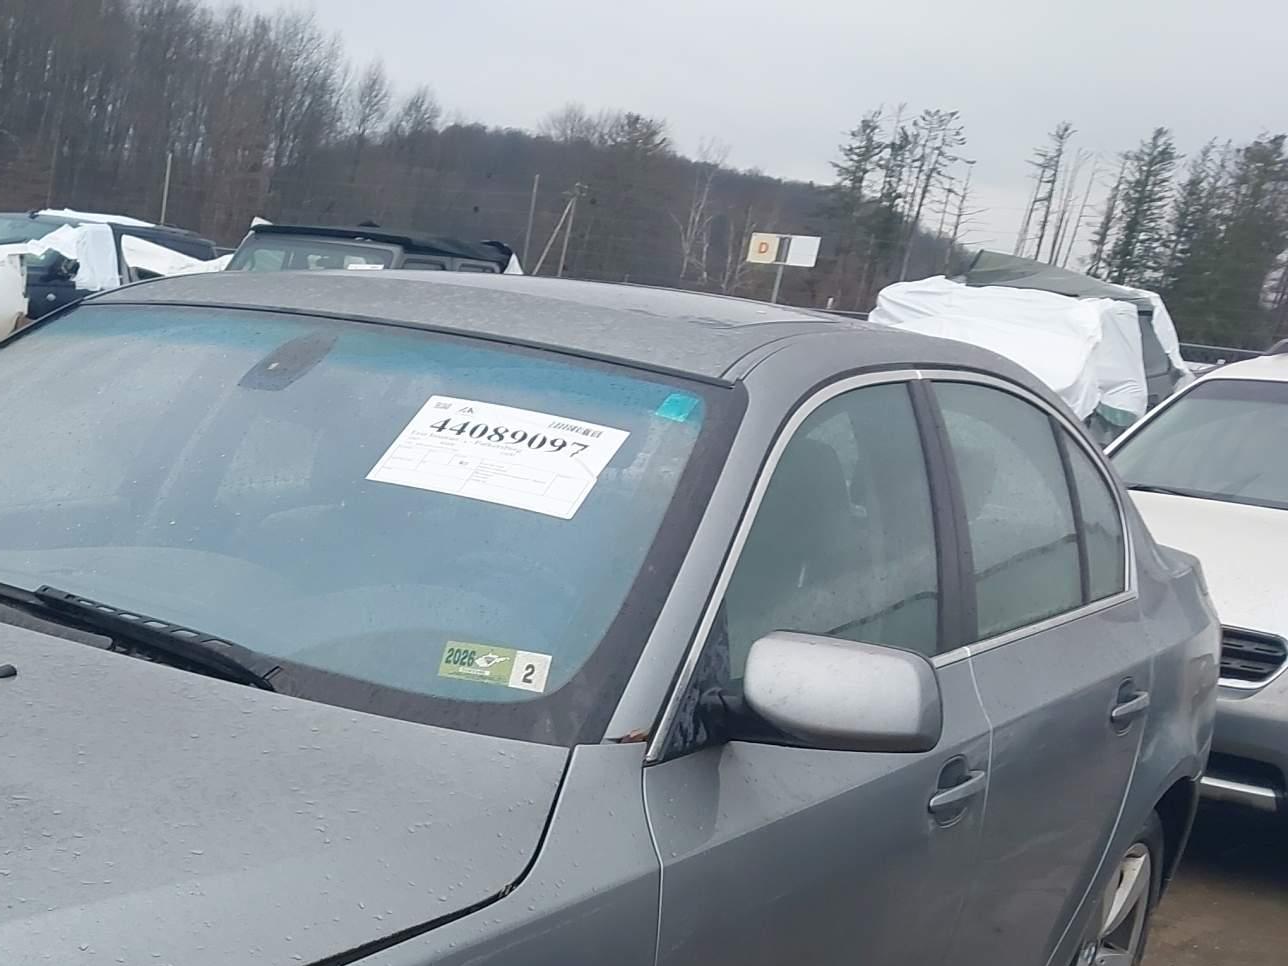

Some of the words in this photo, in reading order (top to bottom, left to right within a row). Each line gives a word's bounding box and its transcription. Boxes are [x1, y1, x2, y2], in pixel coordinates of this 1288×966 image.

[758, 242, 769, 254] D
[429, 417, 591, 458] 44089097
[444, 647, 476, 667] 2026
[521, 663, 536, 684] 2
